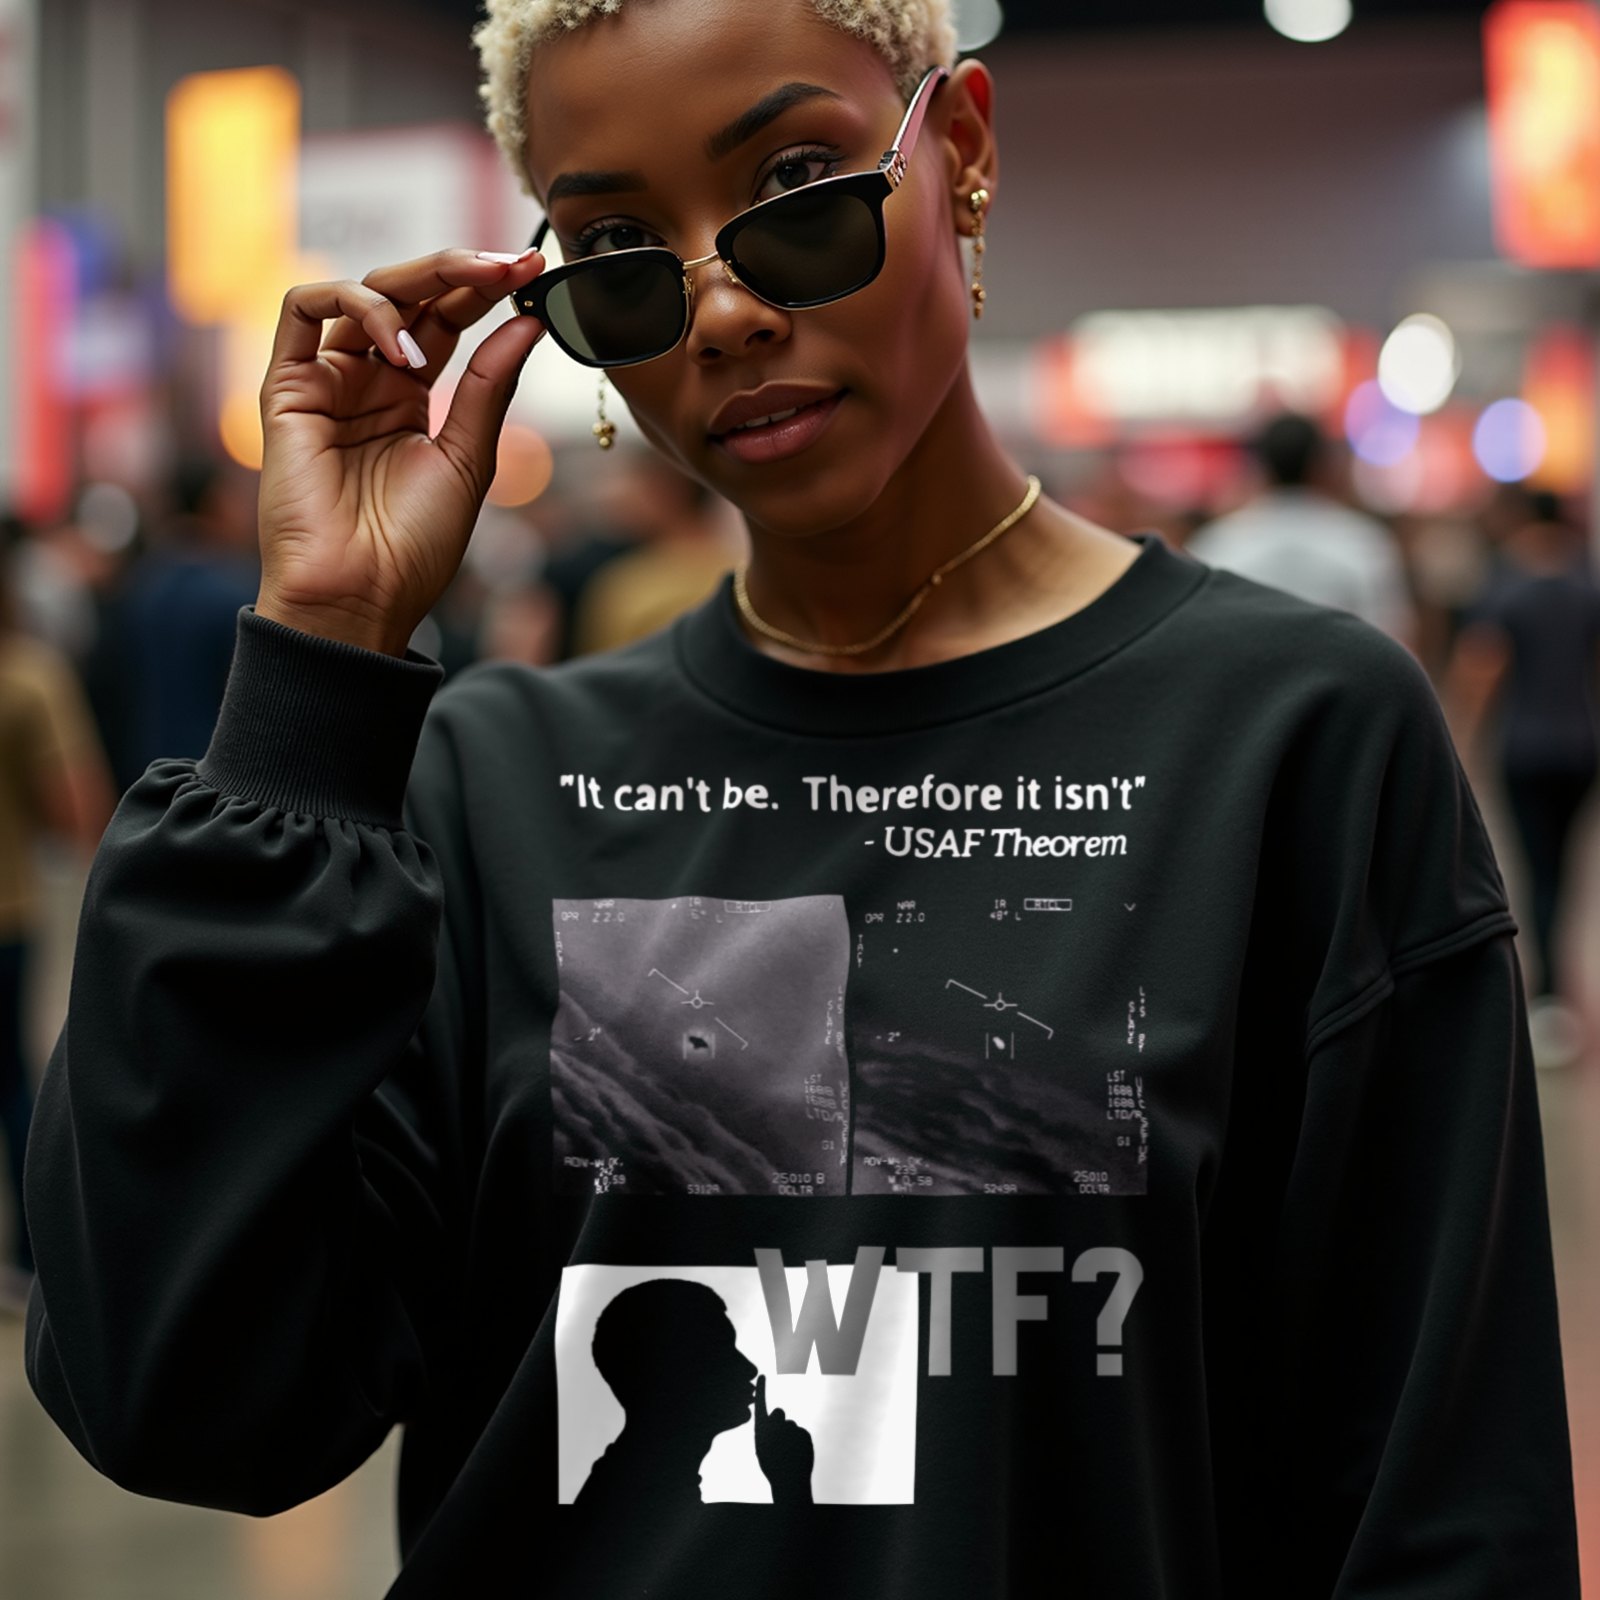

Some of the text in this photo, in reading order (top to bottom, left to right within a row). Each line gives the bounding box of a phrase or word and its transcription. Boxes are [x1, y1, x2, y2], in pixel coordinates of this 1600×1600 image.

[613, 776, 712, 813] can't
[722, 777, 779, 810] be.
[802, 773, 1003, 814] Therefore
[1016, 775, 1042, 811] it
[884, 826, 986, 859] USAF
[990, 827, 1128, 858] Theorem
[1106, 1069, 1125, 1083] LST
[1072, 1170, 1108, 1183] 25010
[753, 1245, 1144, 1377] WTF?
